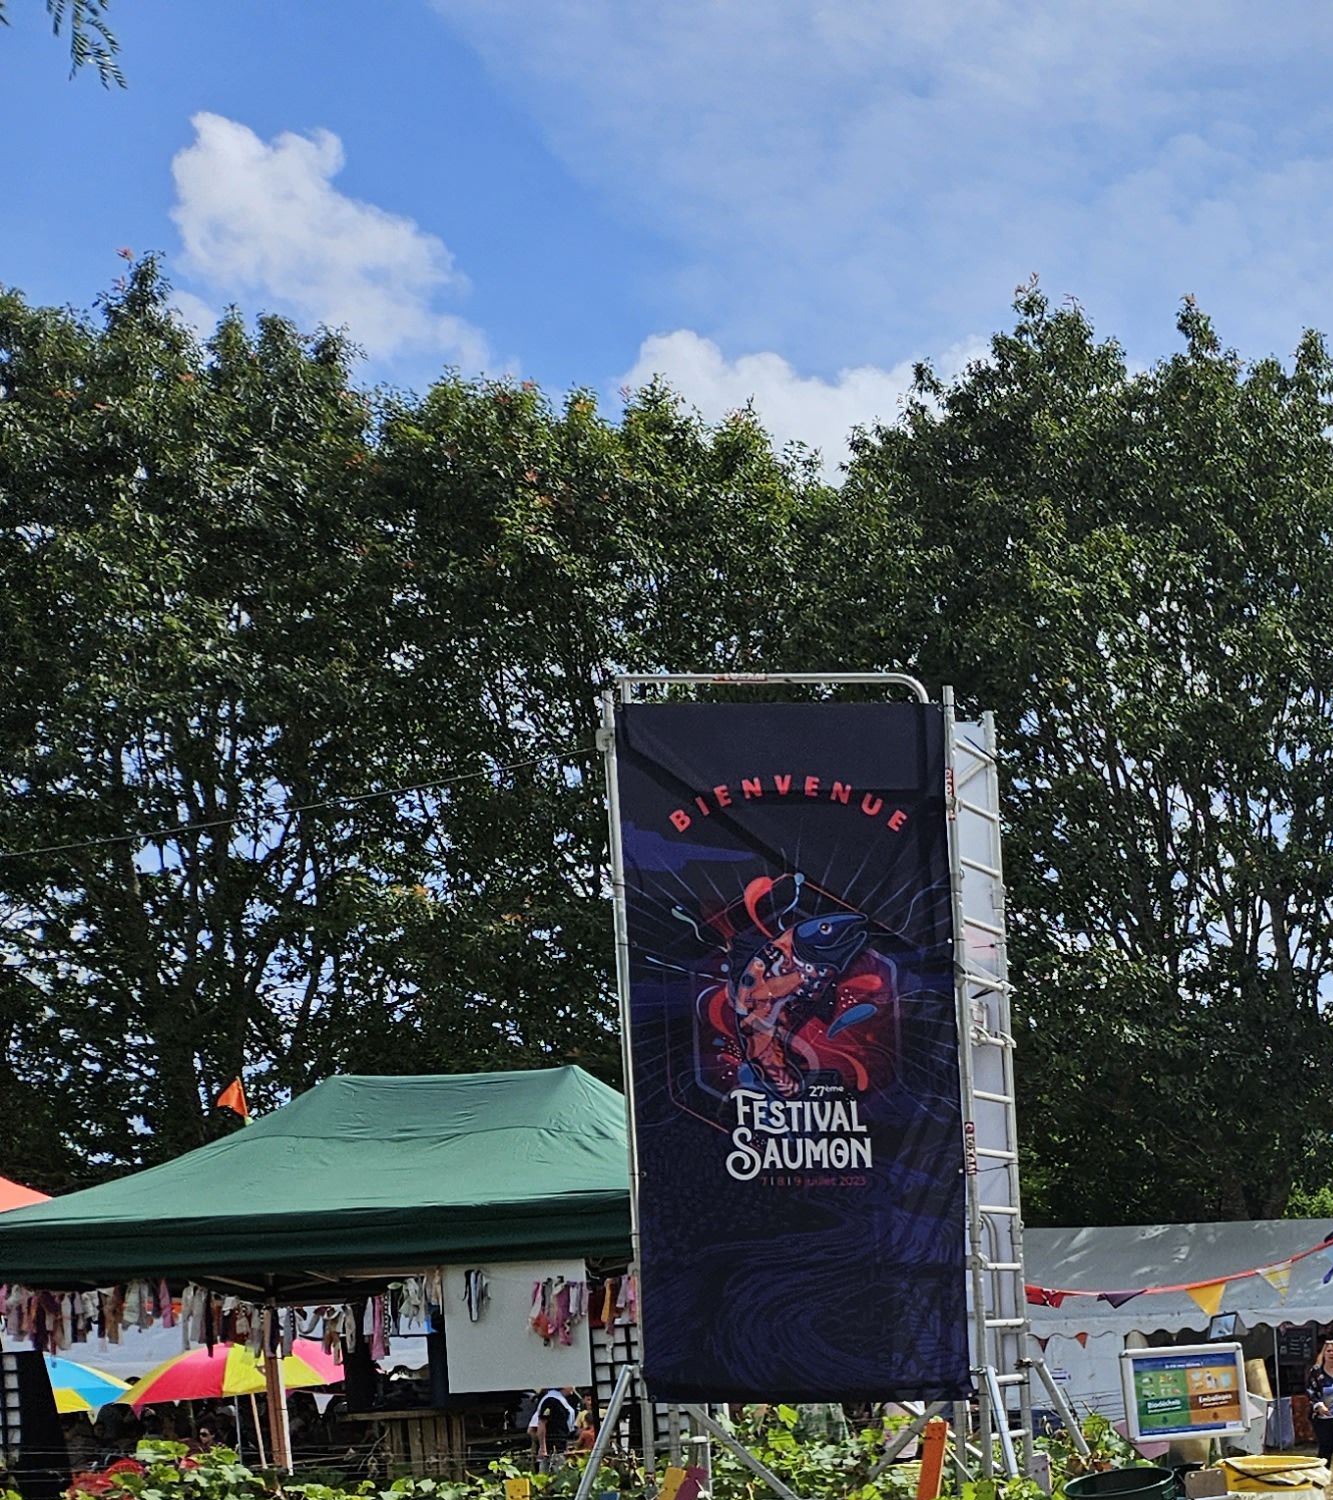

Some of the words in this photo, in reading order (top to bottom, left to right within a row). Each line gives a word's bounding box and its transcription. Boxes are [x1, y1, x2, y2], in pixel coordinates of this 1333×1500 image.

[668, 774, 907, 833] BIENVENUE
[730, 1089, 868, 1134] FESTIVAL
[808, 1085, 844, 1097] 27ème
[726, 1127, 873, 1181] SAUMON
[803, 1176, 835, 1188] juillet
[839, 1175, 867, 1186] 2023
